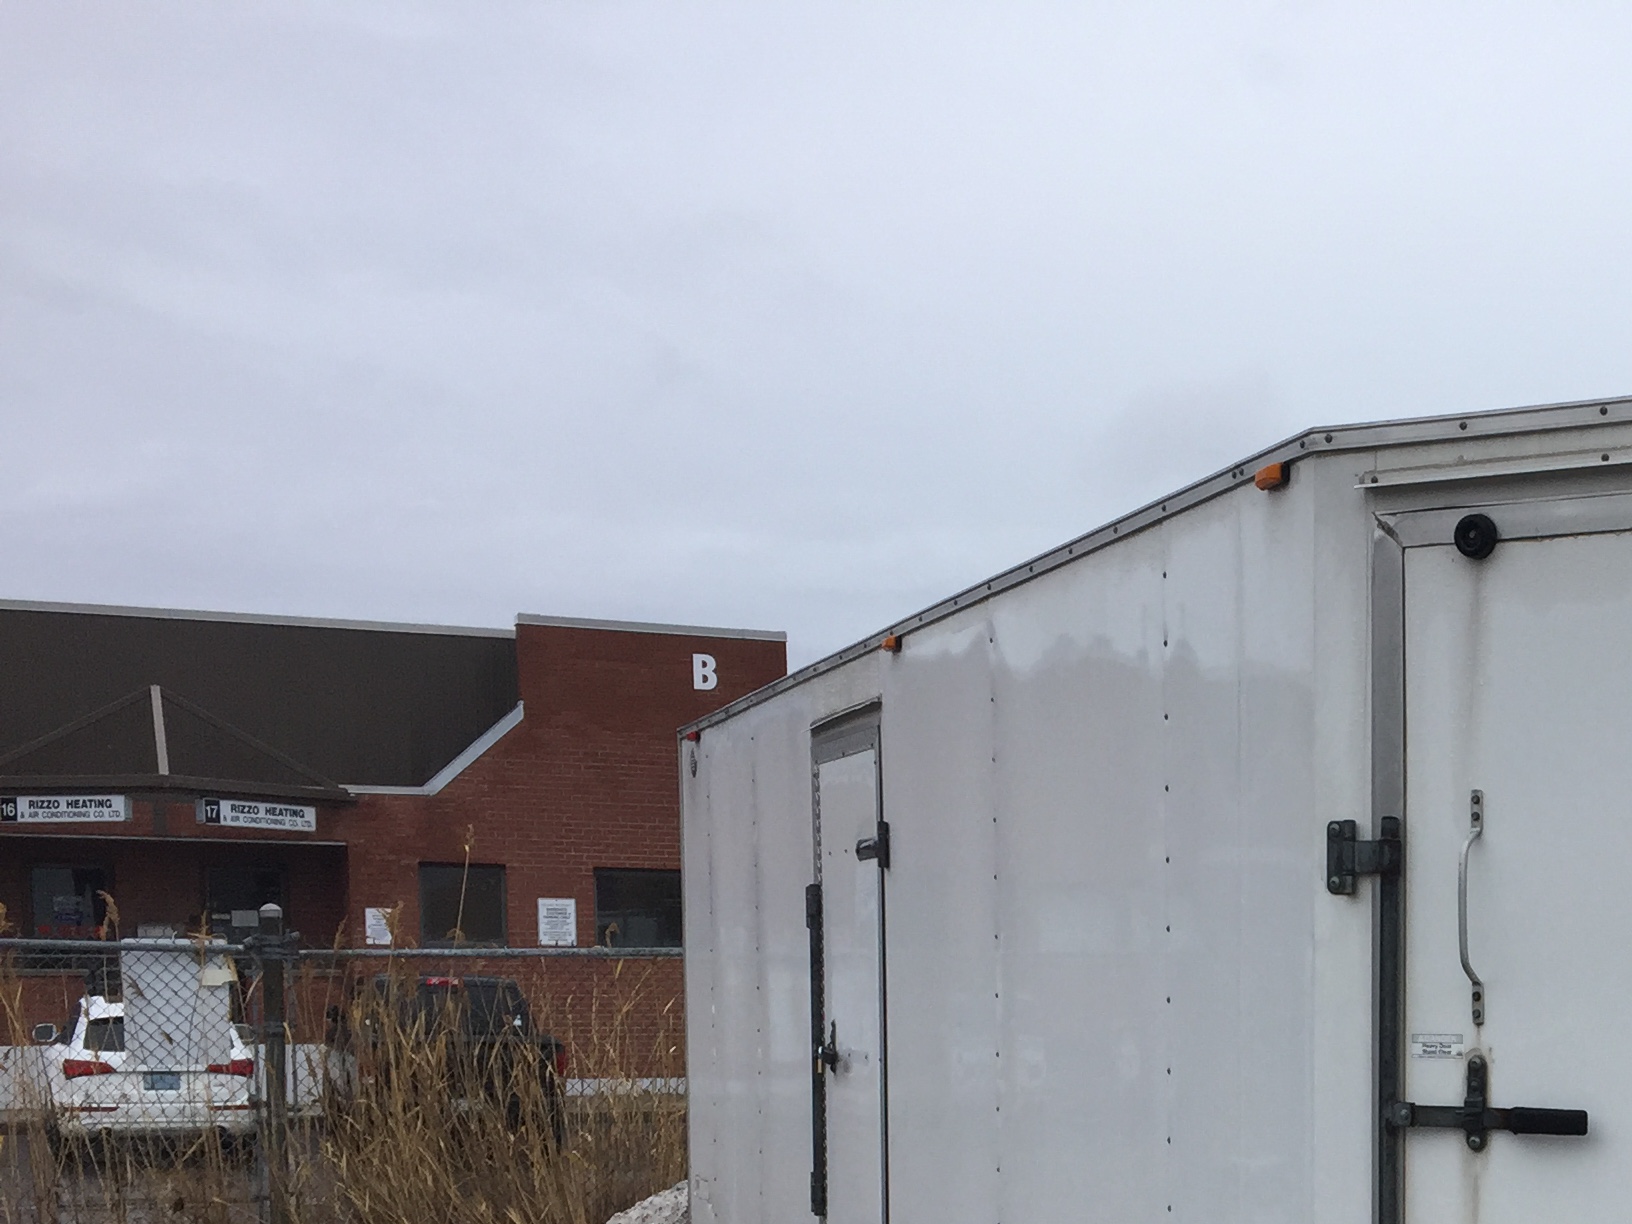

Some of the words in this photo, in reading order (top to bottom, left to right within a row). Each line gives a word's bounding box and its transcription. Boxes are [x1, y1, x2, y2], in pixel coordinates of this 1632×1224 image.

[692, 653, 718, 690] B
[1, 802, 16, 817] 16
[28, 799, 61, 810] RIZZO
[66, 798, 113, 809] HEATING
[230, 803, 260, 815] RIZZO
[264, 806, 305, 819] HEATING
[28, 811, 40, 819] AIR
[41, 810, 91, 819] CONDITIONING
[205, 805, 218, 819] 17
